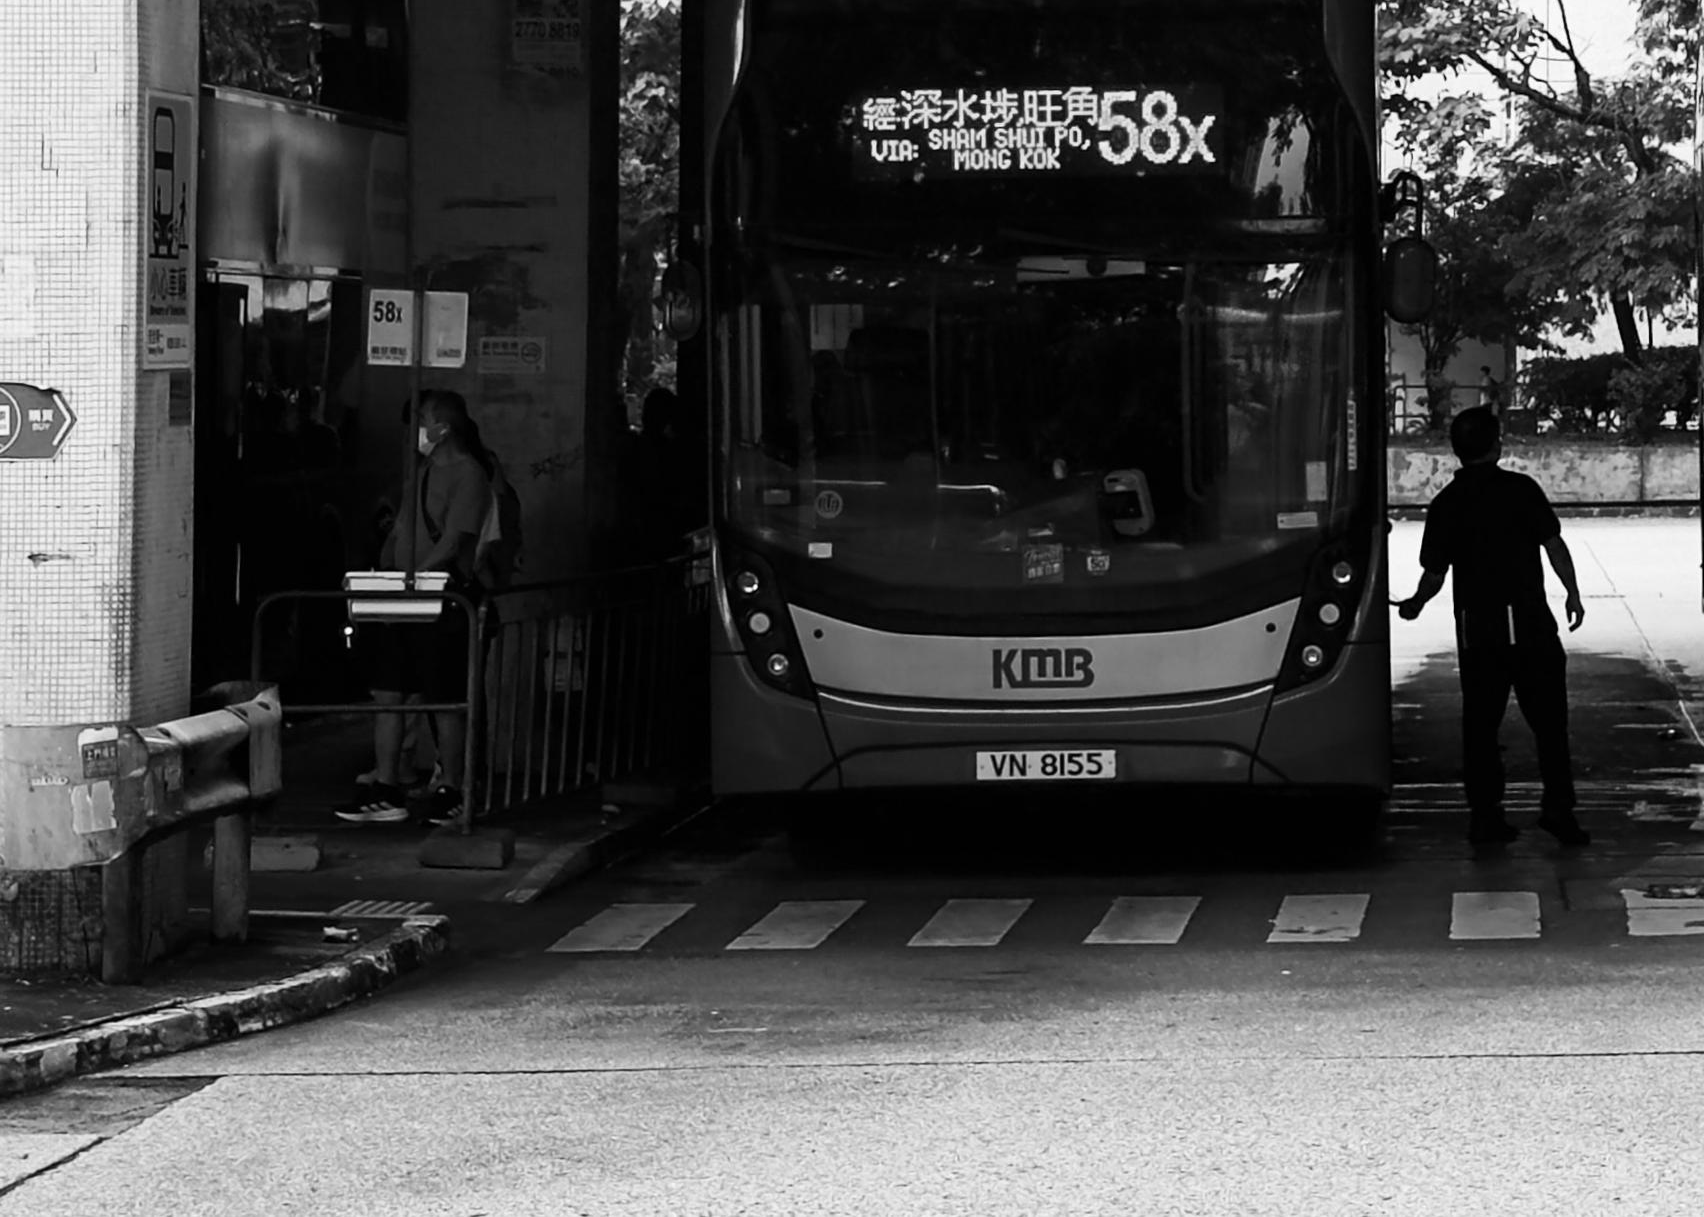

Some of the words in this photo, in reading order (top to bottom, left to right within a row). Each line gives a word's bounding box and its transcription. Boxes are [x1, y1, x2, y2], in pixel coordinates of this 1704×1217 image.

[871, 139, 919, 162] VIA:
[928, 127, 986, 151] SHAM
[994, 126, 1046, 149] SHUI
[1054, 126, 1091, 151] PO,
[954, 149, 1011, 171] MONG
[1020, 148, 1061, 170] KOK
[993, 648, 1095, 689] KMB
[990, 754, 1027, 777] VN
[1040, 753, 1103, 776] 8155
